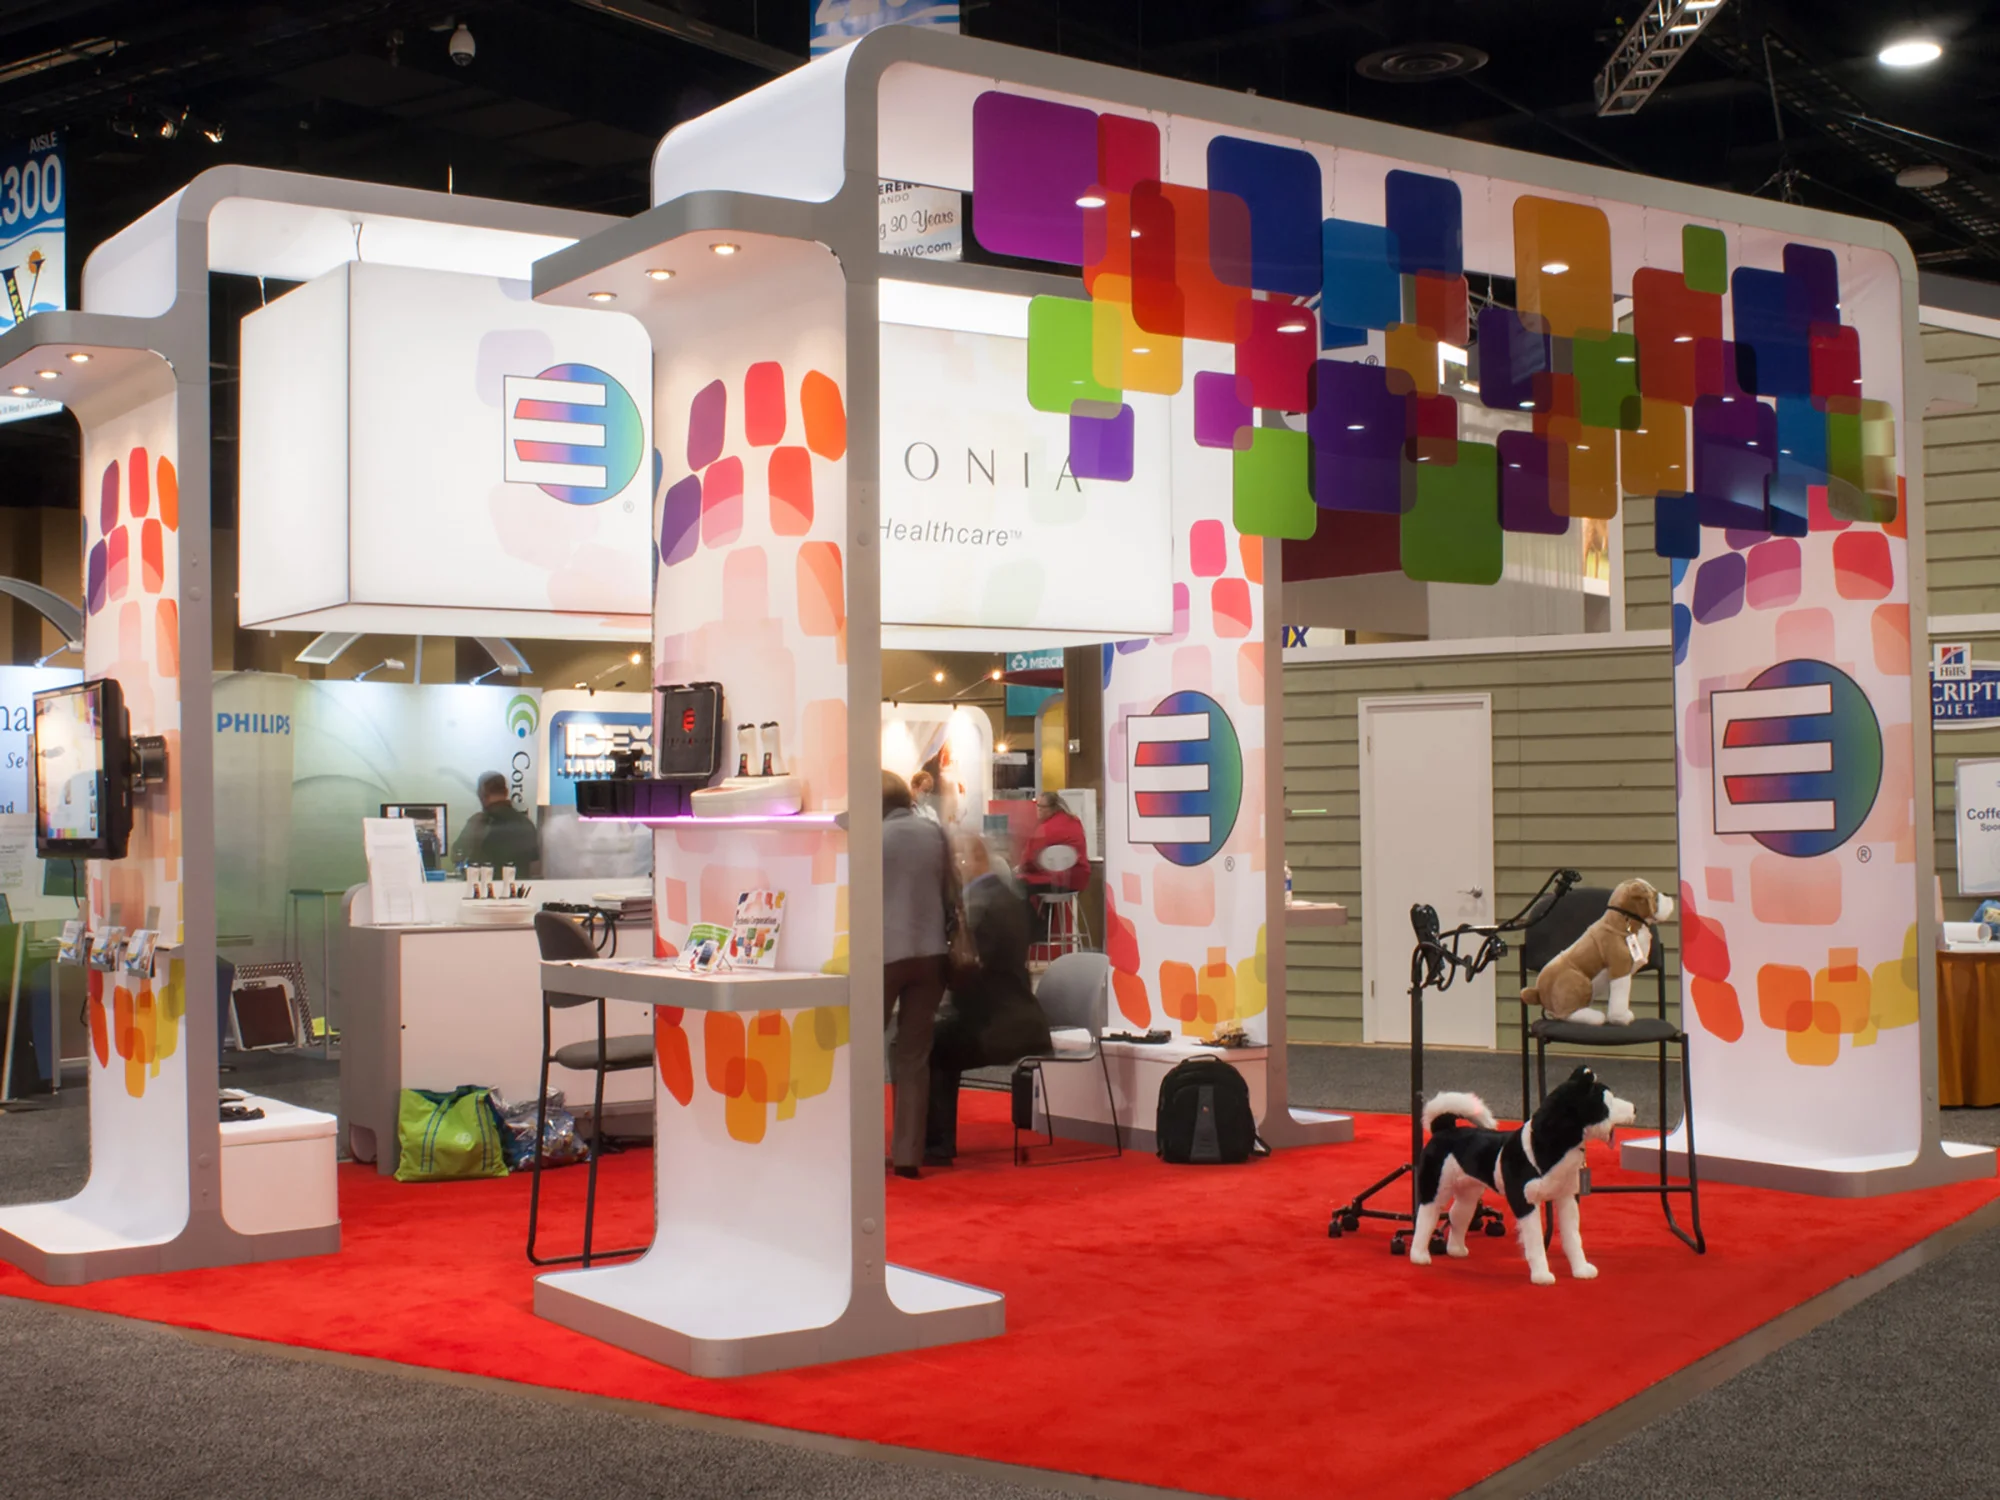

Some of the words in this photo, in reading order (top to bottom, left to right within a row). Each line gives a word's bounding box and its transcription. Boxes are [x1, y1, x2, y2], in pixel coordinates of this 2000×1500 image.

[29, 131, 57, 154] AISLE
[0, 153, 62, 225] 300
[890, 214, 908, 232] 30
[911, 209, 954, 233] Years
[904, 441, 1081, 493] ONIA
[217, 712, 290, 735] PHILIPS
[511, 751, 530, 803] Core
